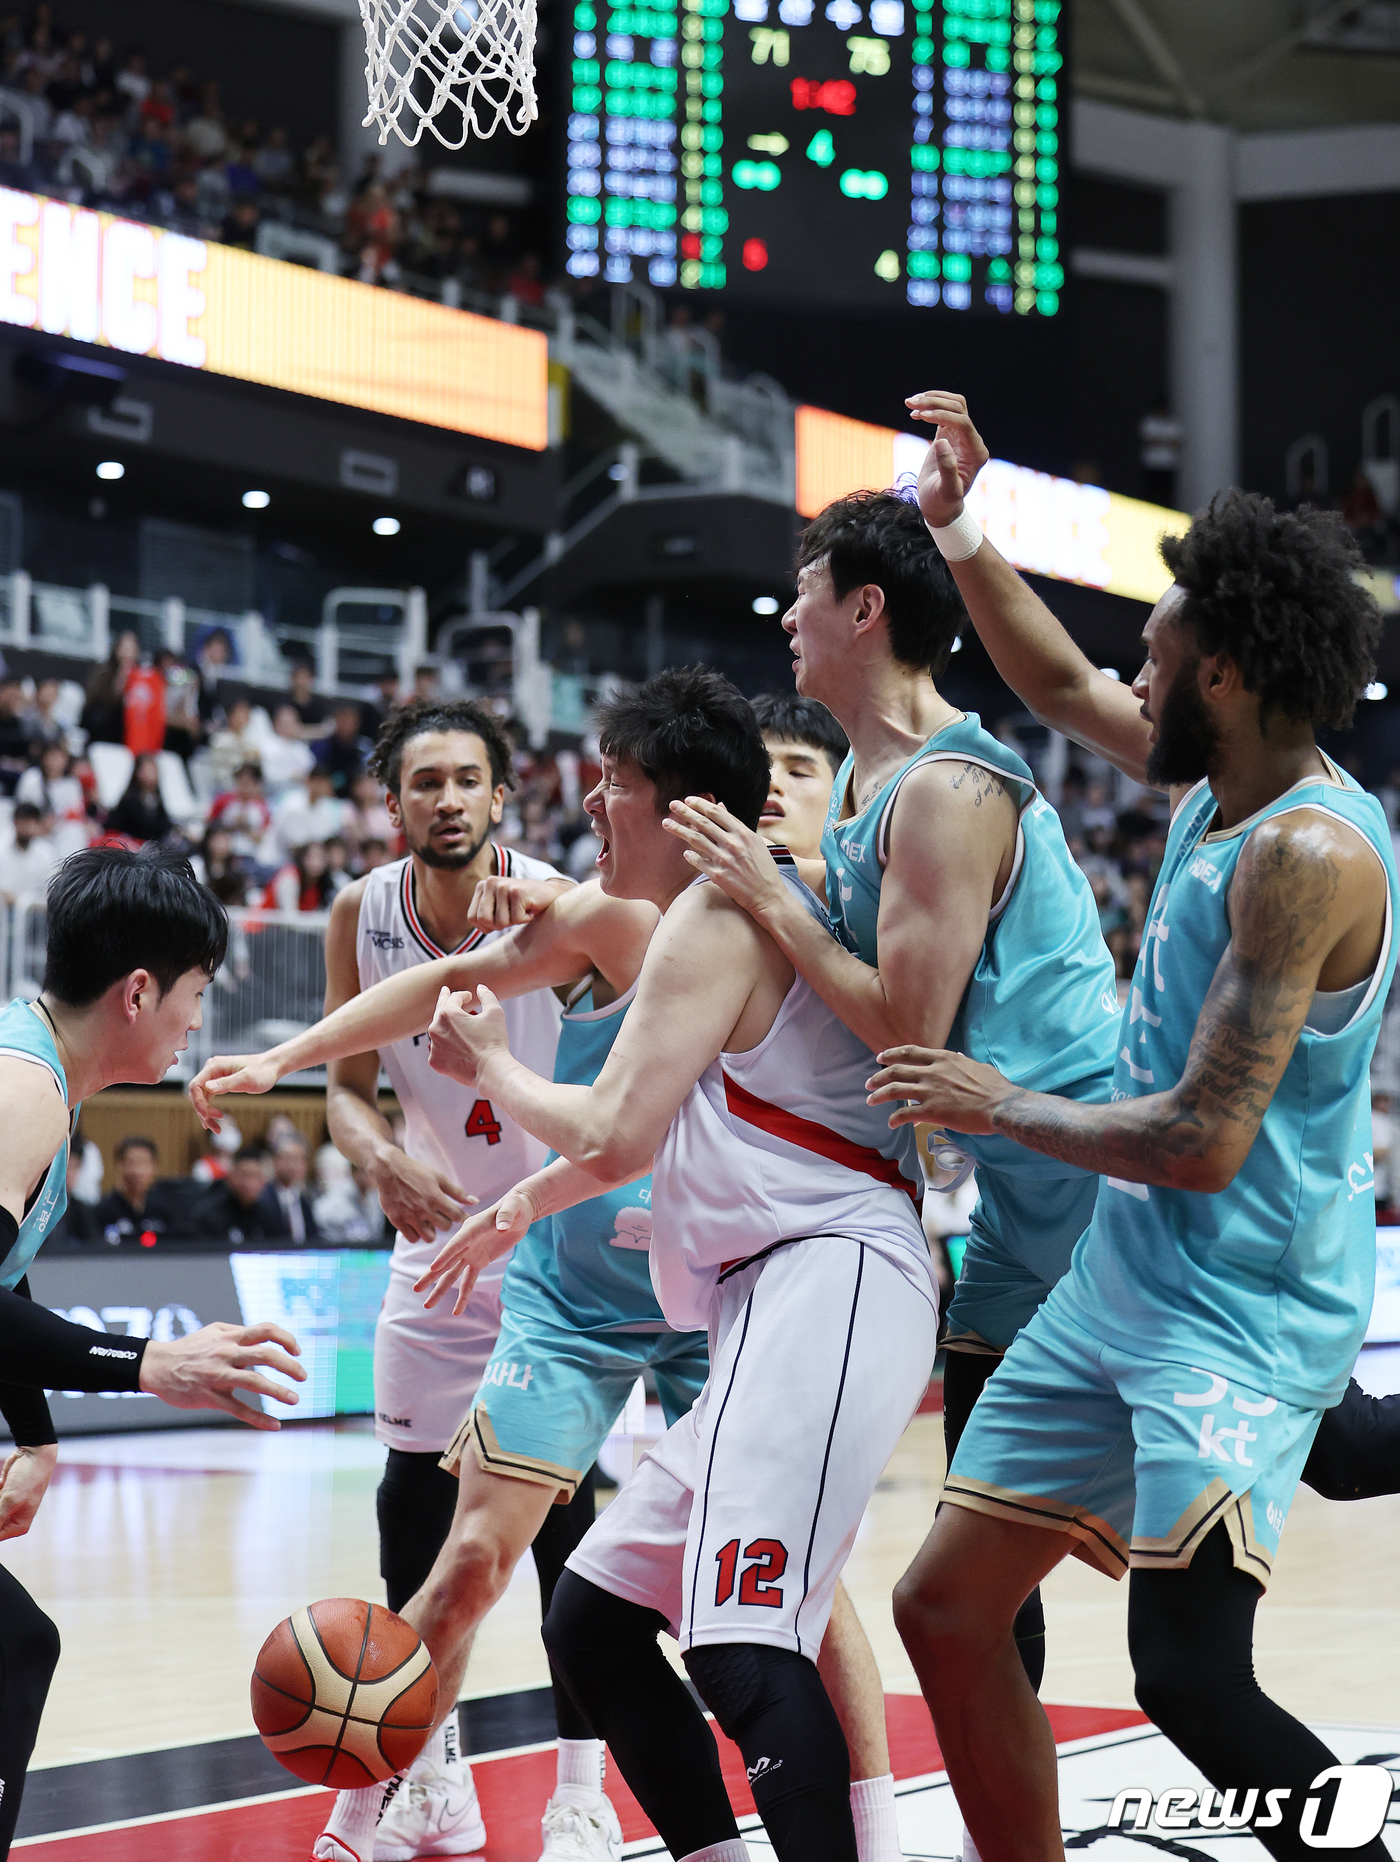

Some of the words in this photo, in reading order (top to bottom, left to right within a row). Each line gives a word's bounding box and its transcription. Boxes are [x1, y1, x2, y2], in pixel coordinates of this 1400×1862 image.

[465, 1099, 503, 1147] 4
[1198, 1413, 1258, 1467] kt
[714, 1537, 789, 1609] 12
